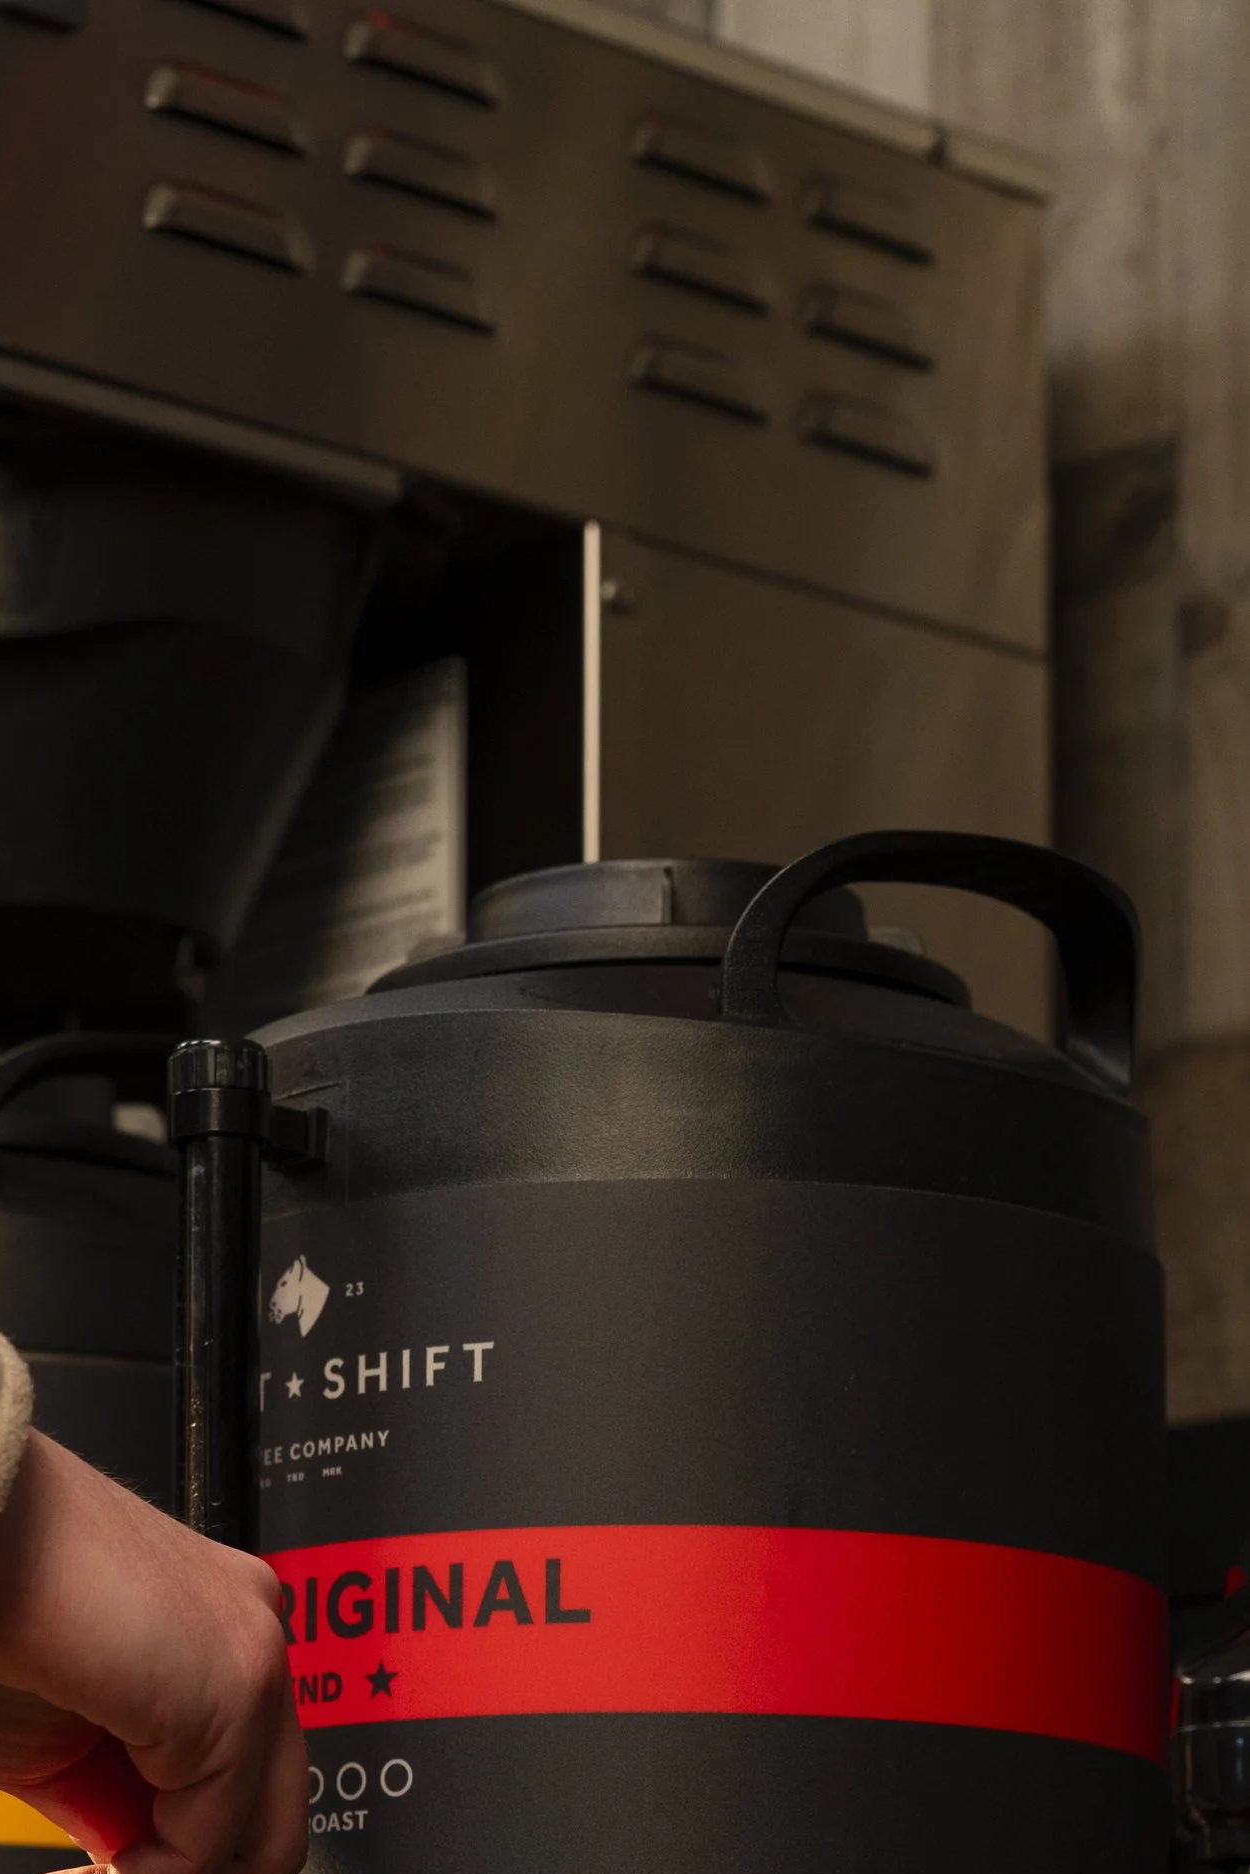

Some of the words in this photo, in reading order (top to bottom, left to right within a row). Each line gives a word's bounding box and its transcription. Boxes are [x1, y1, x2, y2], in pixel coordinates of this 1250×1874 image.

[344, 1281, 365, 1298] 23
[322, 1340, 496, 1401] SHIFT
[289, 1429, 391, 1462] COMPANY
[309, 1809, 369, 1834] OAST
